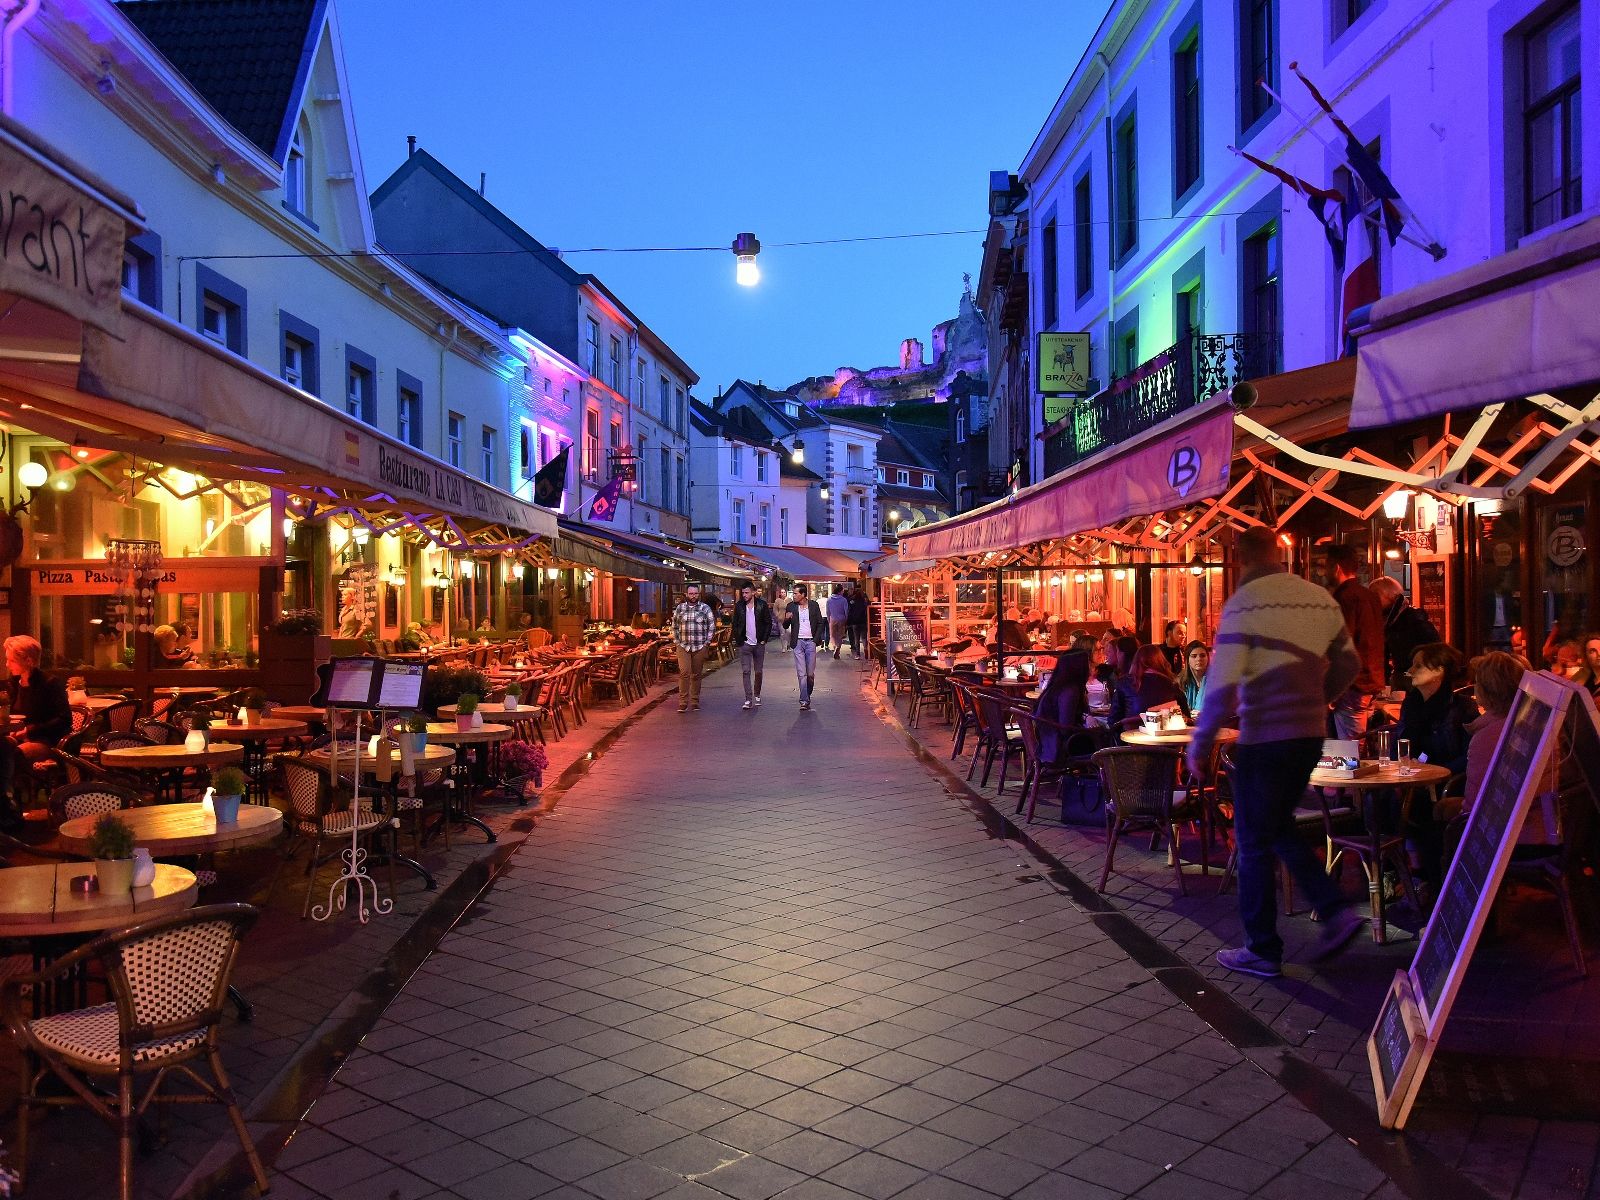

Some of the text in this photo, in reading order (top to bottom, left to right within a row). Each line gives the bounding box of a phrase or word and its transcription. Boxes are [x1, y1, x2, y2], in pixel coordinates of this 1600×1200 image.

[0, 190, 95, 297] rant
[1045, 372, 1085, 390] BRAZZA
[379, 445, 431, 497] Restaurante
[39, 570, 73, 584] Pizza
